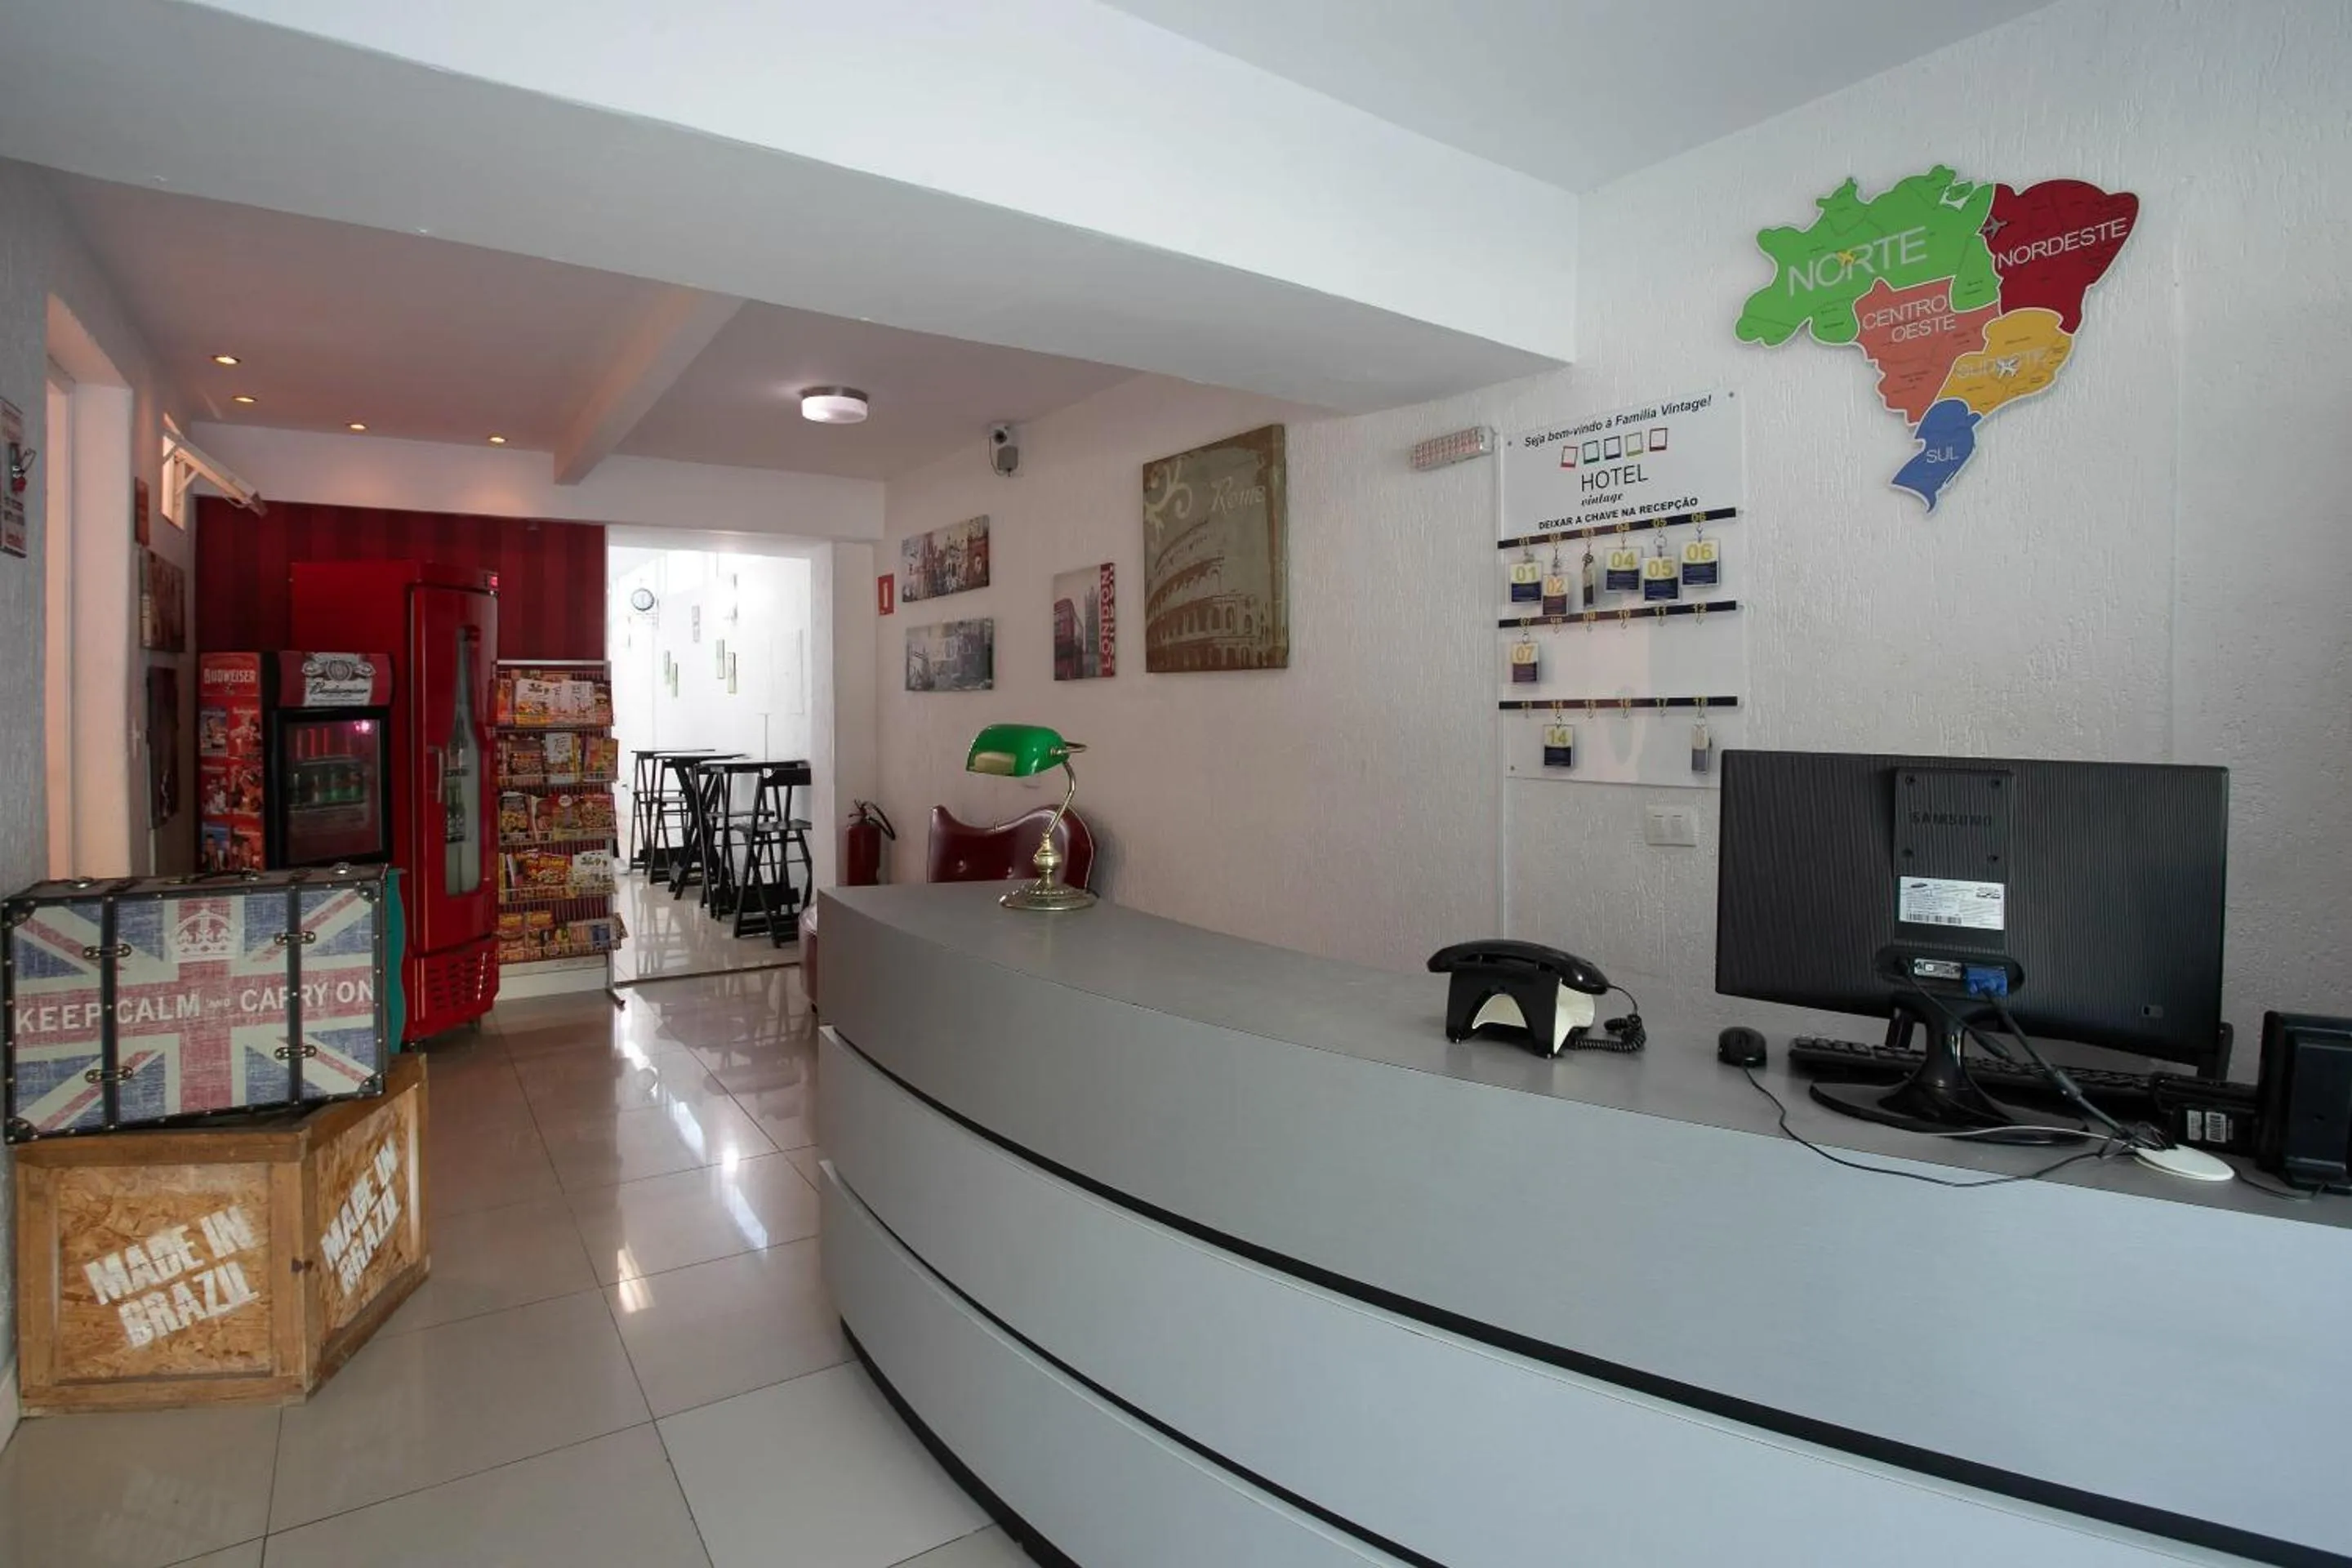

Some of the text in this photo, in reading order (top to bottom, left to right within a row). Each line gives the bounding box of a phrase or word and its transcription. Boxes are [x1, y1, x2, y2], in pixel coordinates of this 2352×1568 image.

[1998, 217, 2127, 270] NORDESTE
[1788, 225, 1927, 296] NORTE
[1863, 294, 1947, 331] CENTRO
[1891, 314, 1956, 343] OESTE
[1524, 434, 1545, 448] Seja
[1548, 421, 1603, 442] bem-vindo
[1661, 394, 1713, 416] Vintage!
[1926, 446, 1958, 464] SUL
[1582, 464, 1648, 492] HOTEL
[1581, 492, 1624, 507] vintage
[1539, 497, 1699, 530] DEIXAR A CHAVE NA RECEPÇÃO
[1611, 552, 1637, 568] 04
[1686, 542, 1713, 561] 06
[1516, 566, 1536, 582] 01
[1647, 559, 1673, 578] 05
[1546, 577, 1564, 595] 02
[1516, 646, 1535, 662] 07
[203, 668, 257, 684] BUDWEISER
[1548, 729, 1568, 744] 14
[1909, 811, 1992, 826] SAMSUNG
[15, 1005, 102, 1035] KEEP
[117, 994, 200, 1025] CALM
[336, 980, 375, 1004] ON
[374, 1134, 399, 1185] IN
[84, 1205, 256, 1306] MADE IN
[118, 1261, 260, 1349] BRAZIL
